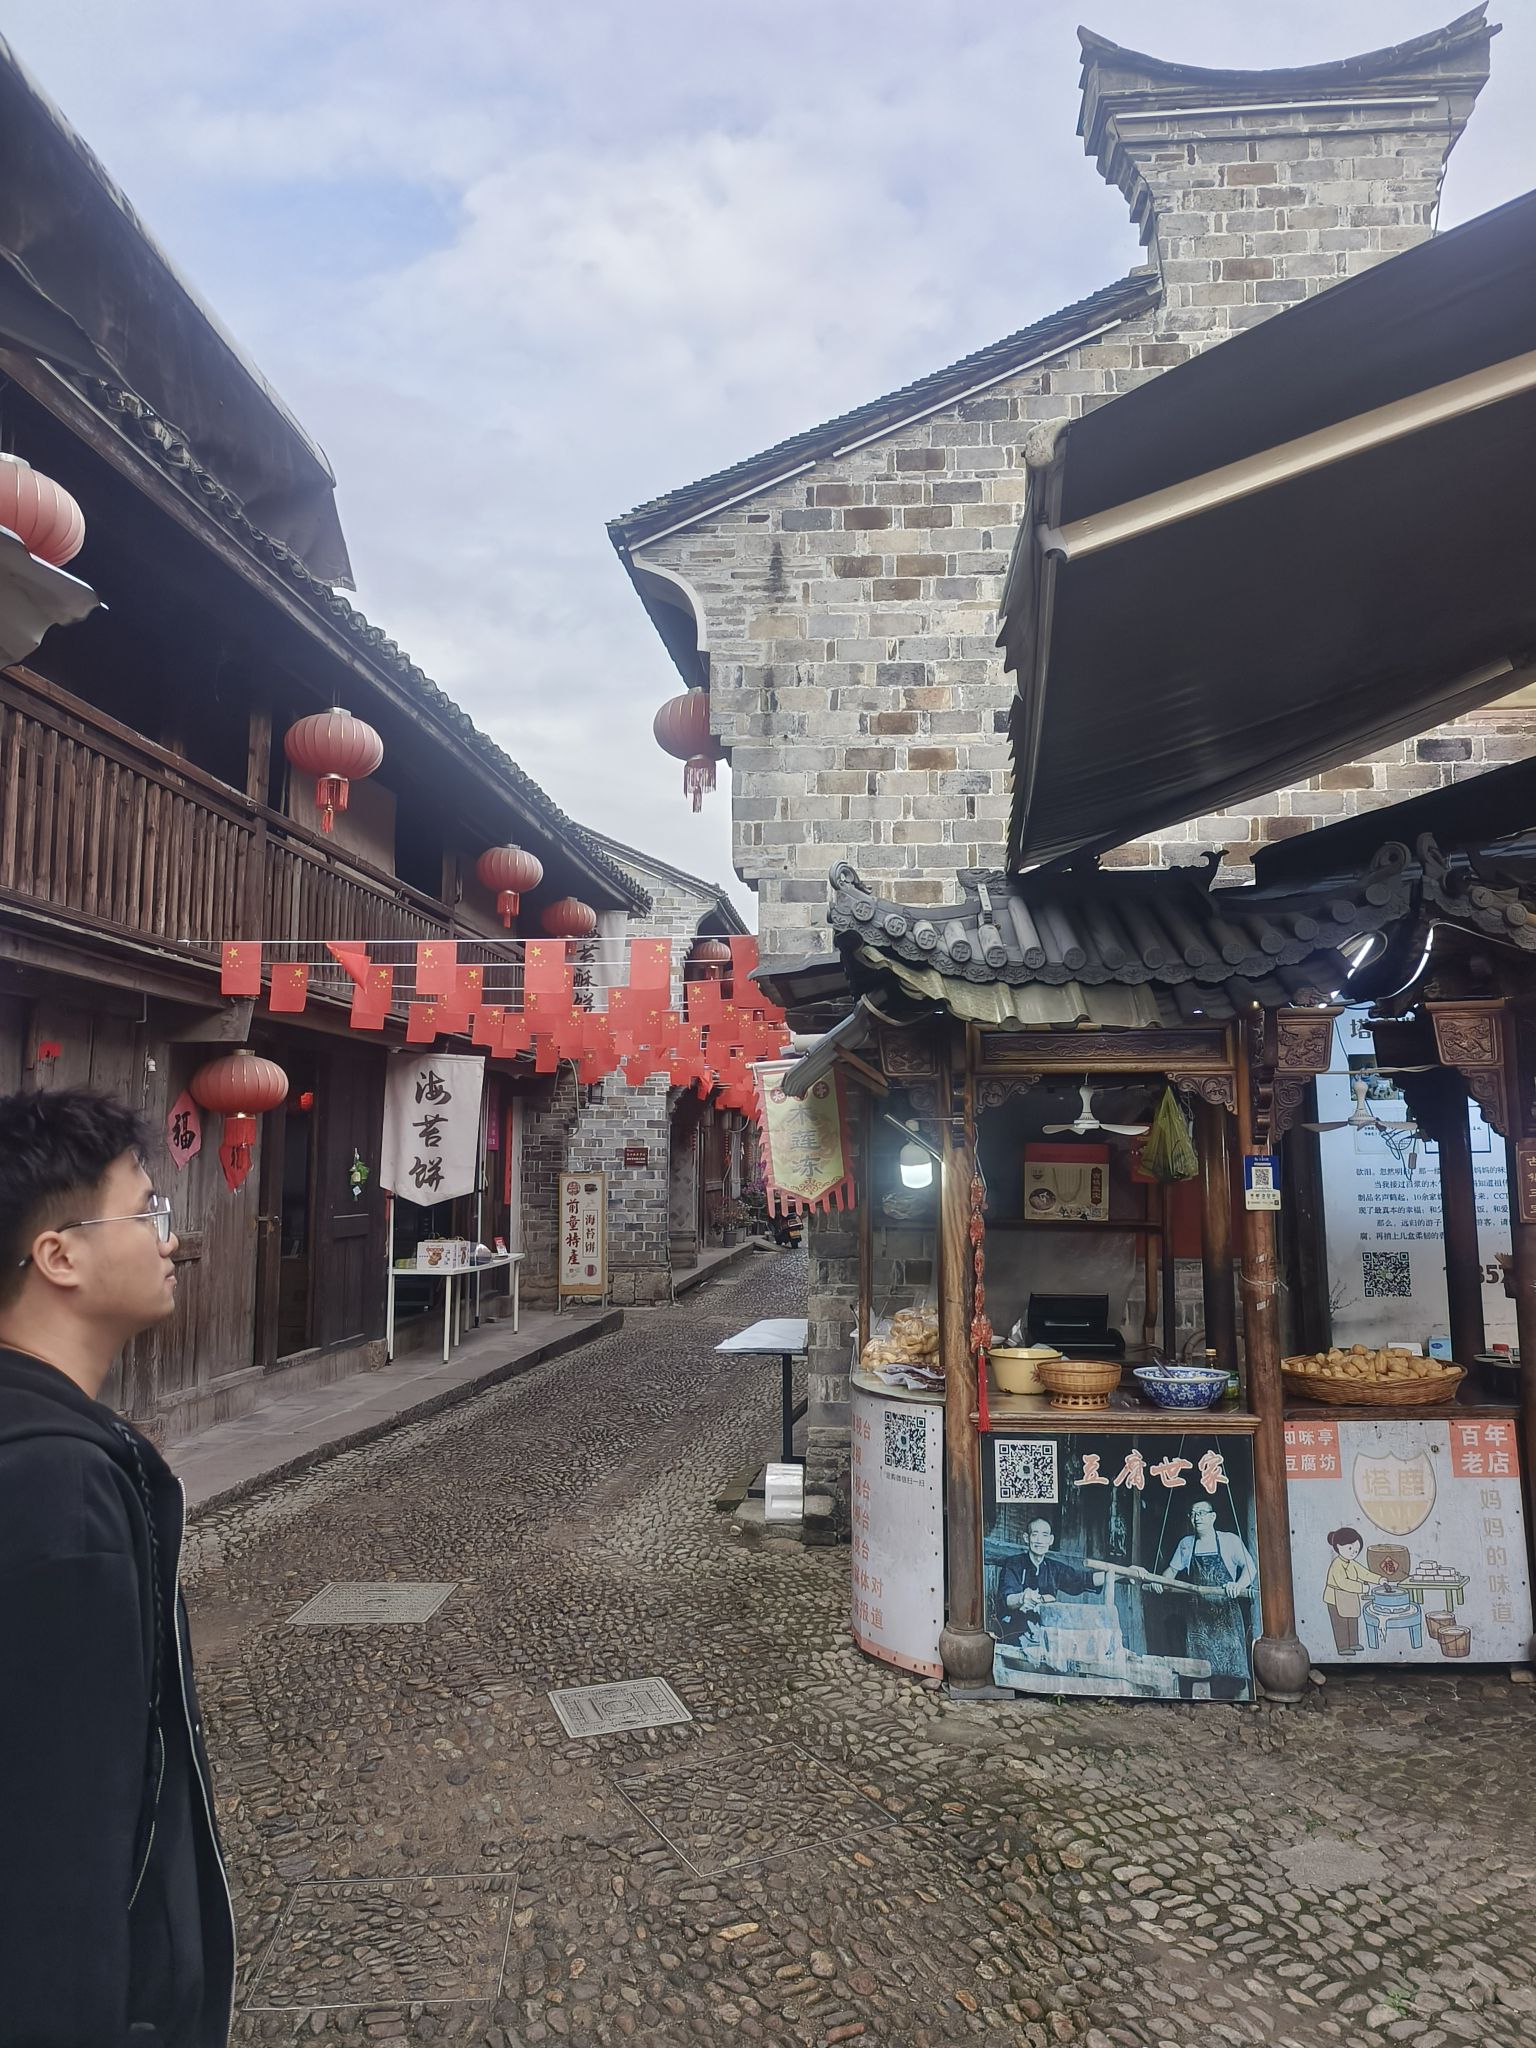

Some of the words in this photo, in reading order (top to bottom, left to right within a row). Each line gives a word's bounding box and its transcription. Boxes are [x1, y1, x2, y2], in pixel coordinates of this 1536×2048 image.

[172, 1111, 196, 1150] 福
[409, 1070, 452, 1193] 海苔饼
[787, 1104, 823, 1177] 木莲冻
[1458, 1424, 1508, 1447] 百年
[1074, 1449, 1230, 1494] 豆腐世家
[1285, 1454, 1336, 1471] 豆腐坊
[1461, 1451, 1509, 1474] 老店
[1480, 1487, 1514, 1623] 妈妈的味道
